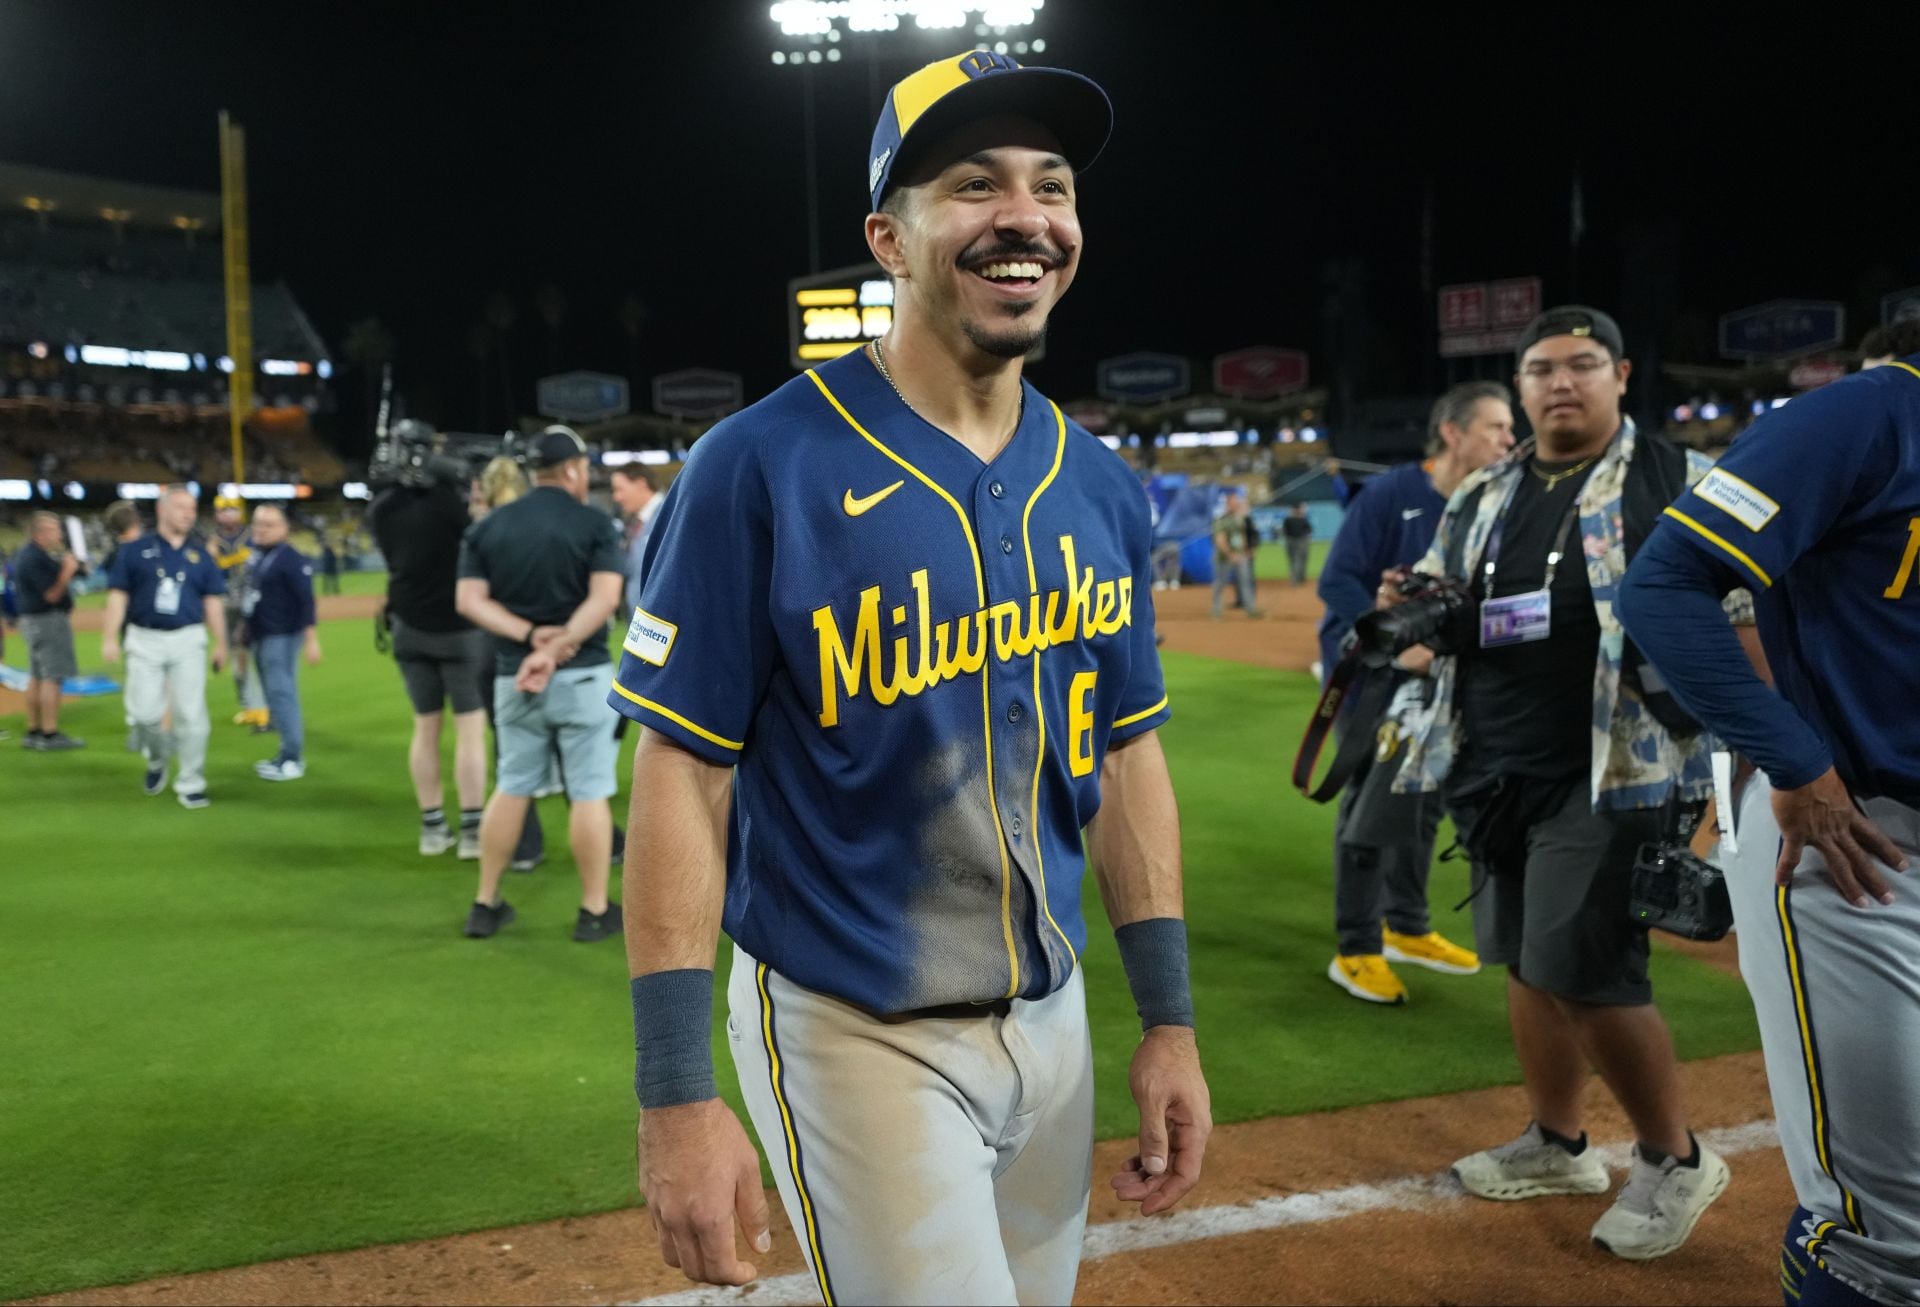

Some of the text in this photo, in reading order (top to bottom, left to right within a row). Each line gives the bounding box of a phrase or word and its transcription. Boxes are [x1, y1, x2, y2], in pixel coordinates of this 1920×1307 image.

[1713, 486, 1740, 507] Mutual
[1720, 480, 1770, 519] Northwestern
[1067, 670, 1099, 778] 6
